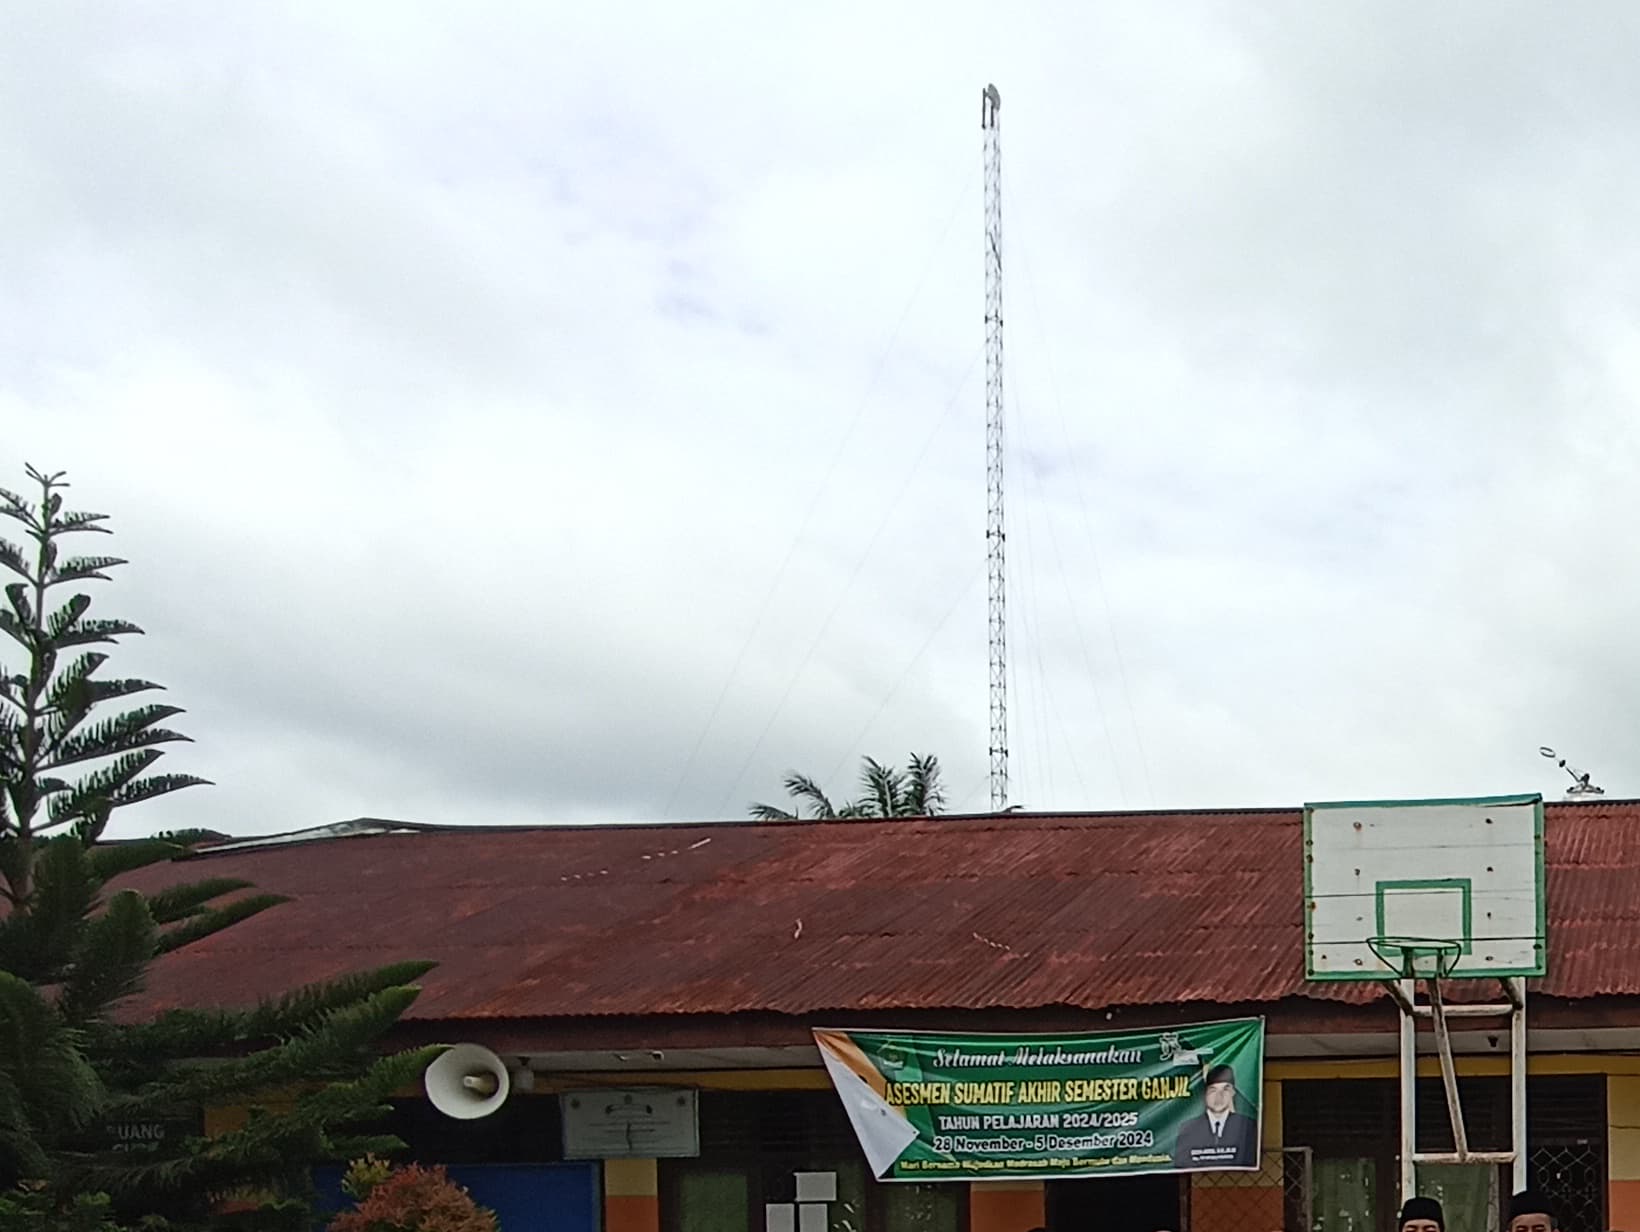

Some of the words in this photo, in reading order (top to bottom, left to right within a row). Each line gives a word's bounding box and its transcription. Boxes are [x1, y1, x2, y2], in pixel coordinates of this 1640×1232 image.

[932, 1048, 1004, 1067] Selamat
[1008, 1045, 1142, 1066] Melaksanakan
[886, 1082, 950, 1104] ASESMEN
[954, 1082, 1015, 1104] SUMATIF
[1018, 1081, 1061, 1104] AKHIR
[1064, 1078, 1138, 1102] SEMESTER
[1142, 1076, 1191, 1099] GANJIL
[938, 1116, 980, 1131] TAHUN
[983, 1114, 1059, 1130] PELAJARAN
[1063, 1112, 1138, 1128] 2024/2025
[934, 1136, 953, 1152] 28
[955, 1136, 1024, 1152] November
[1034, 1135, 1045, 1151] 5
[1047, 1132, 1115, 1151] Desember
[1117, 1130, 1153, 1148] 2024
